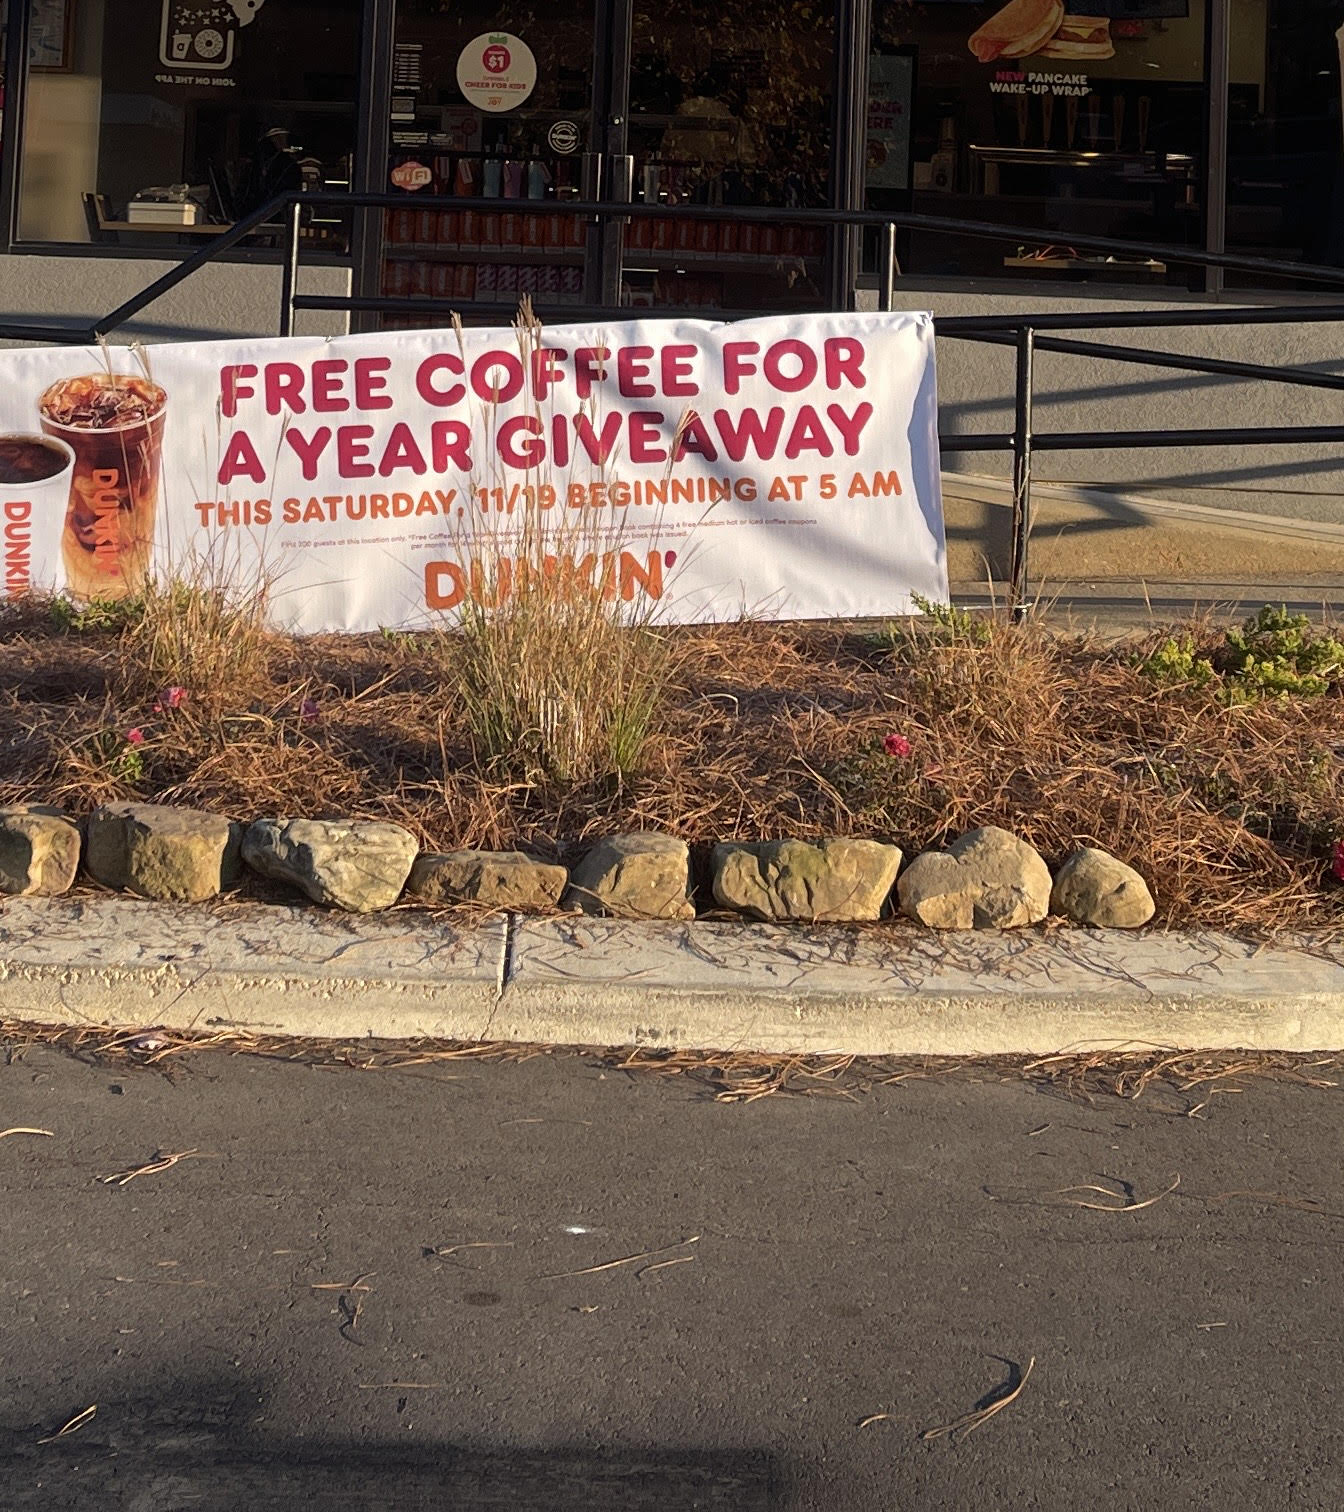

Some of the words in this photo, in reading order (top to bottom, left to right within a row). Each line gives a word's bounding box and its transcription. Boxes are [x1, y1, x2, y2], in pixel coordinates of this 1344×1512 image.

[989, 82, 1049, 95] WAKE-UP
[996, 71, 1025, 81] NEW
[1028, 72, 1088, 85] PANCAKE
[220, 356, 393, 418] FREE
[416, 345, 699, 408] COFFEE
[722, 337, 867, 396] FOR
[217, 430, 266, 485] A
[285, 420, 474, 481] YEAR
[496, 401, 874, 470] GIVEAWAY
[194, 499, 272, 527] THIS
[282, 489, 465, 524] SATURDAY,
[476, 483, 556, 516] 11/19
[567, 476, 758, 509] BEGINNING
[767, 475, 809, 502] AT
[819, 474, 837, 499] 5
[848, 470, 903, 498] AM
